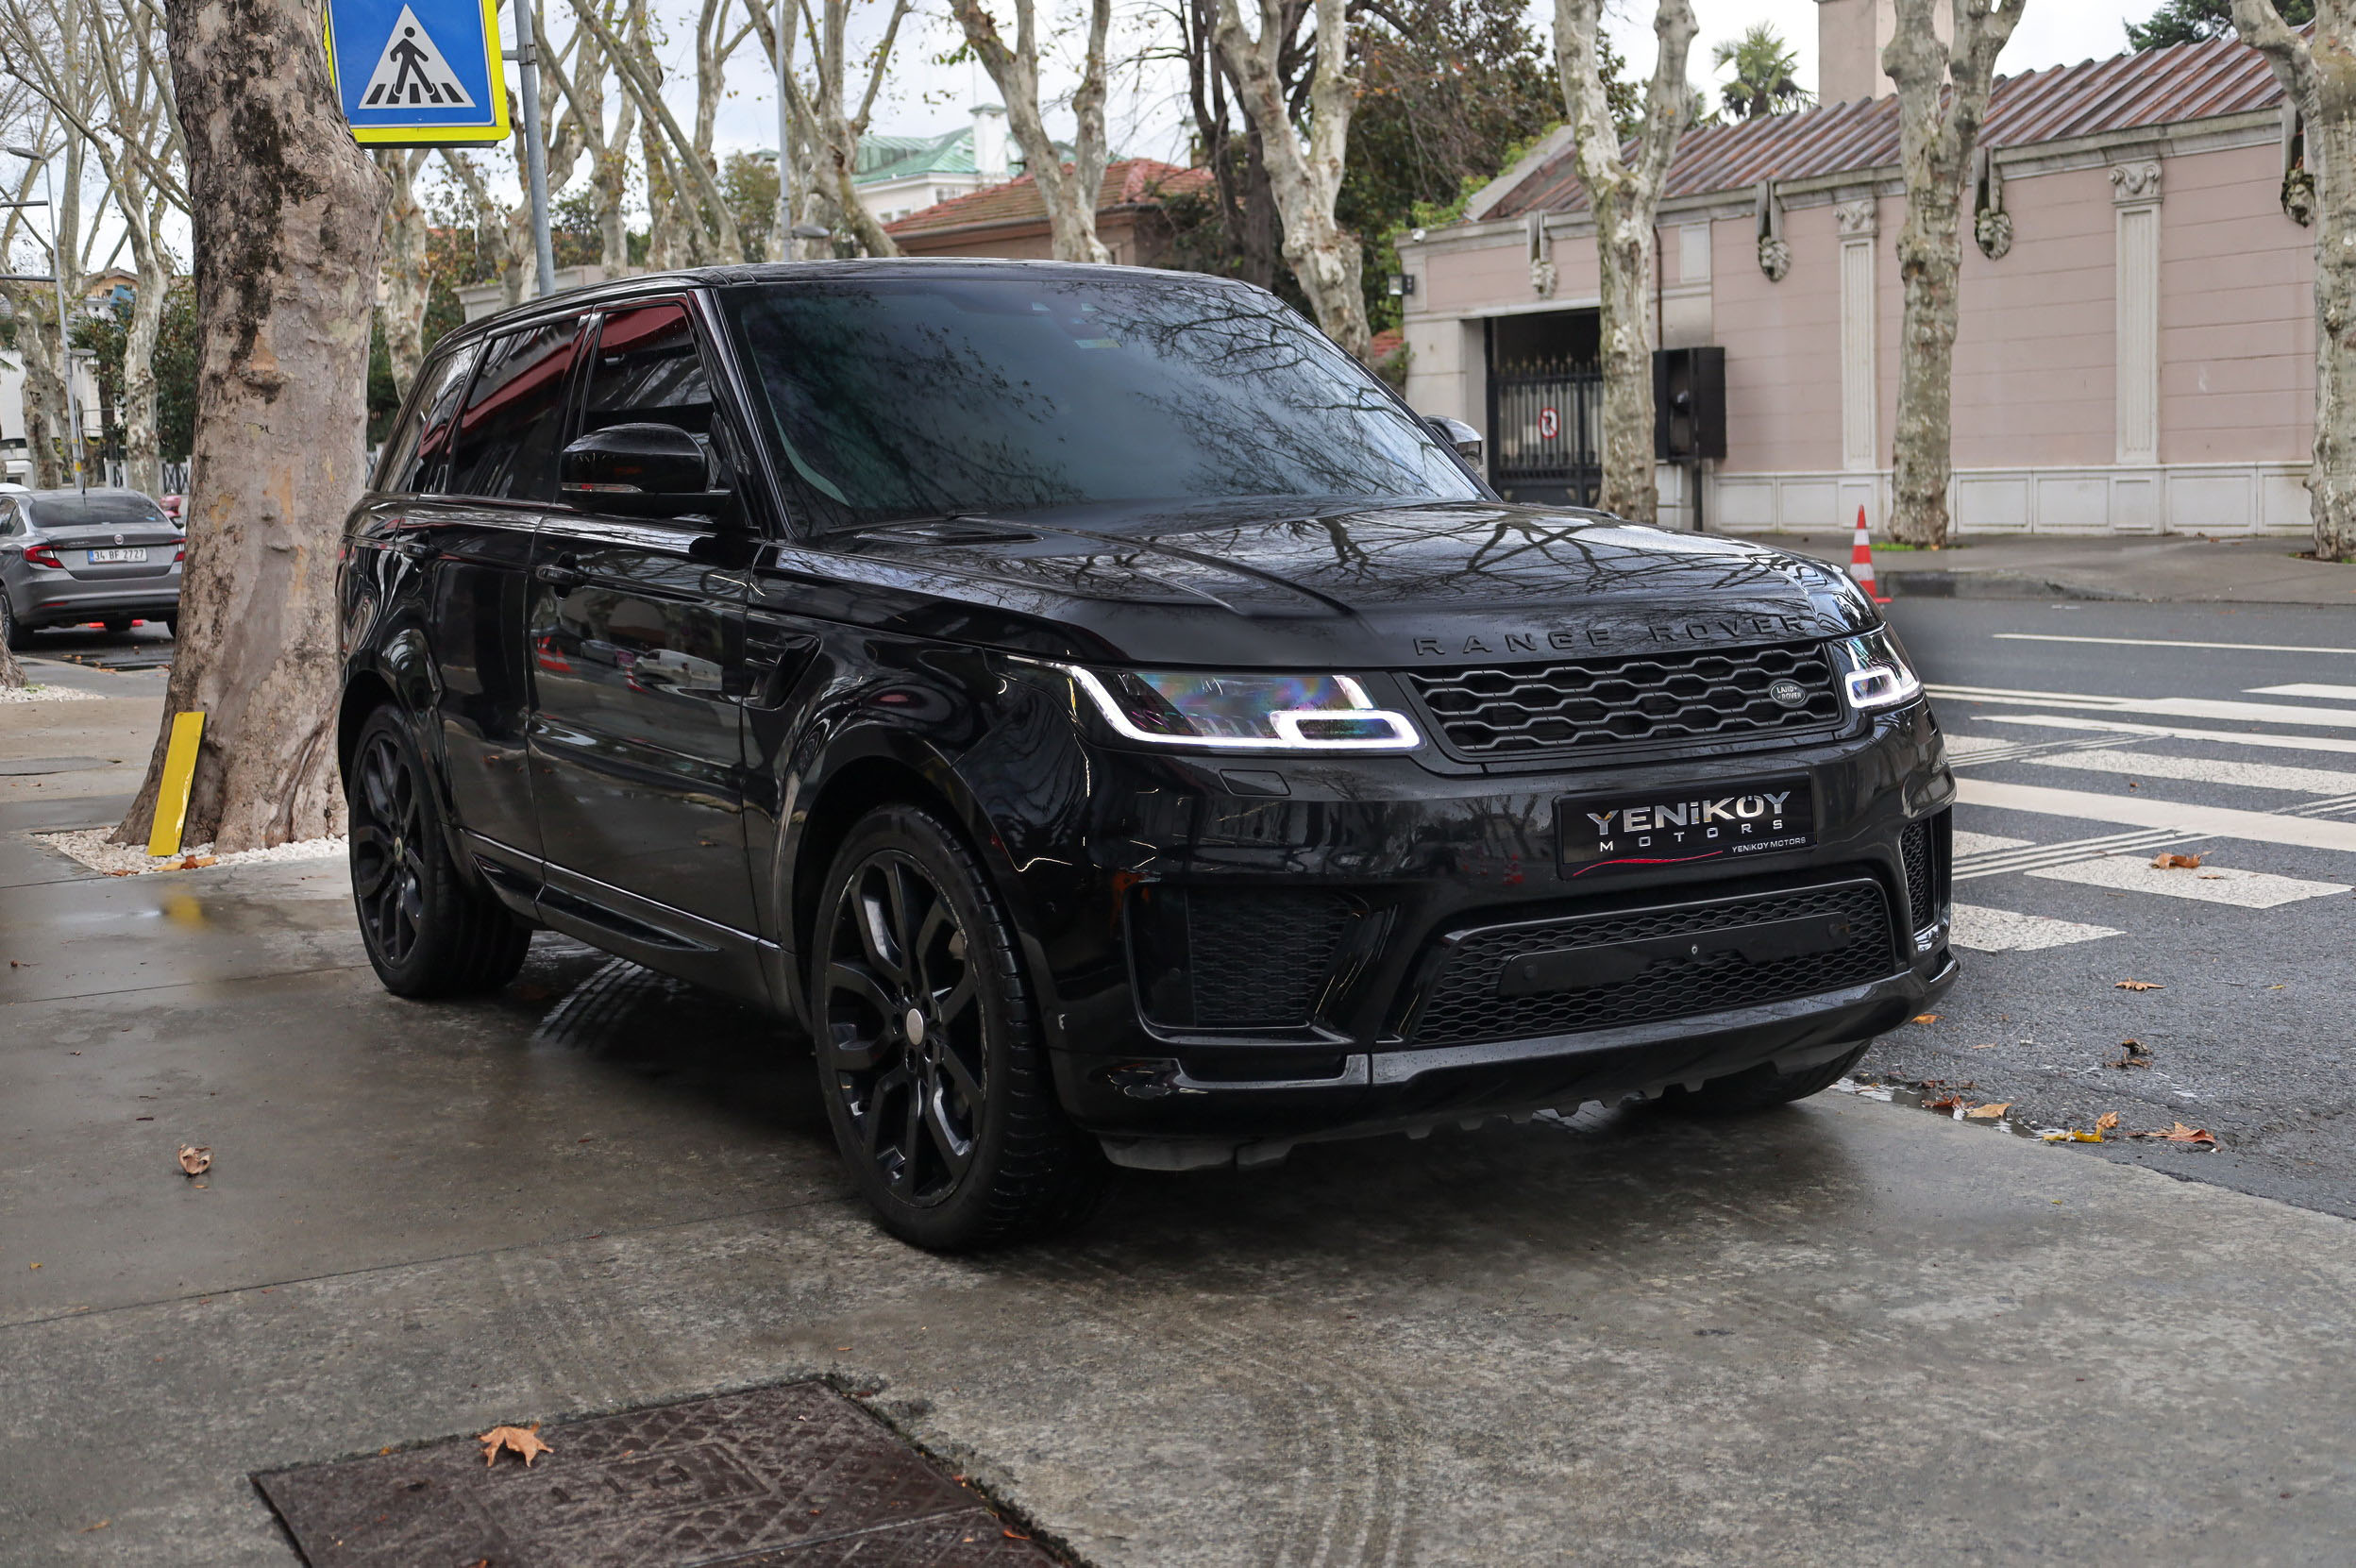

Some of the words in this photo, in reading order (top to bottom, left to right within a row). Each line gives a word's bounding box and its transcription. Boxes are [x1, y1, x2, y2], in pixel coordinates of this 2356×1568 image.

[94, 551, 106, 561] 34
[109, 550, 120, 559] BF
[123, 548, 144, 559] 2727
[1414, 629, 1612, 655] RANGE
[1649, 616, 1807, 642] ROVER
[1599, 819, 1783, 851] MOTORS
[1770, 836, 1807, 848] MOTORS
